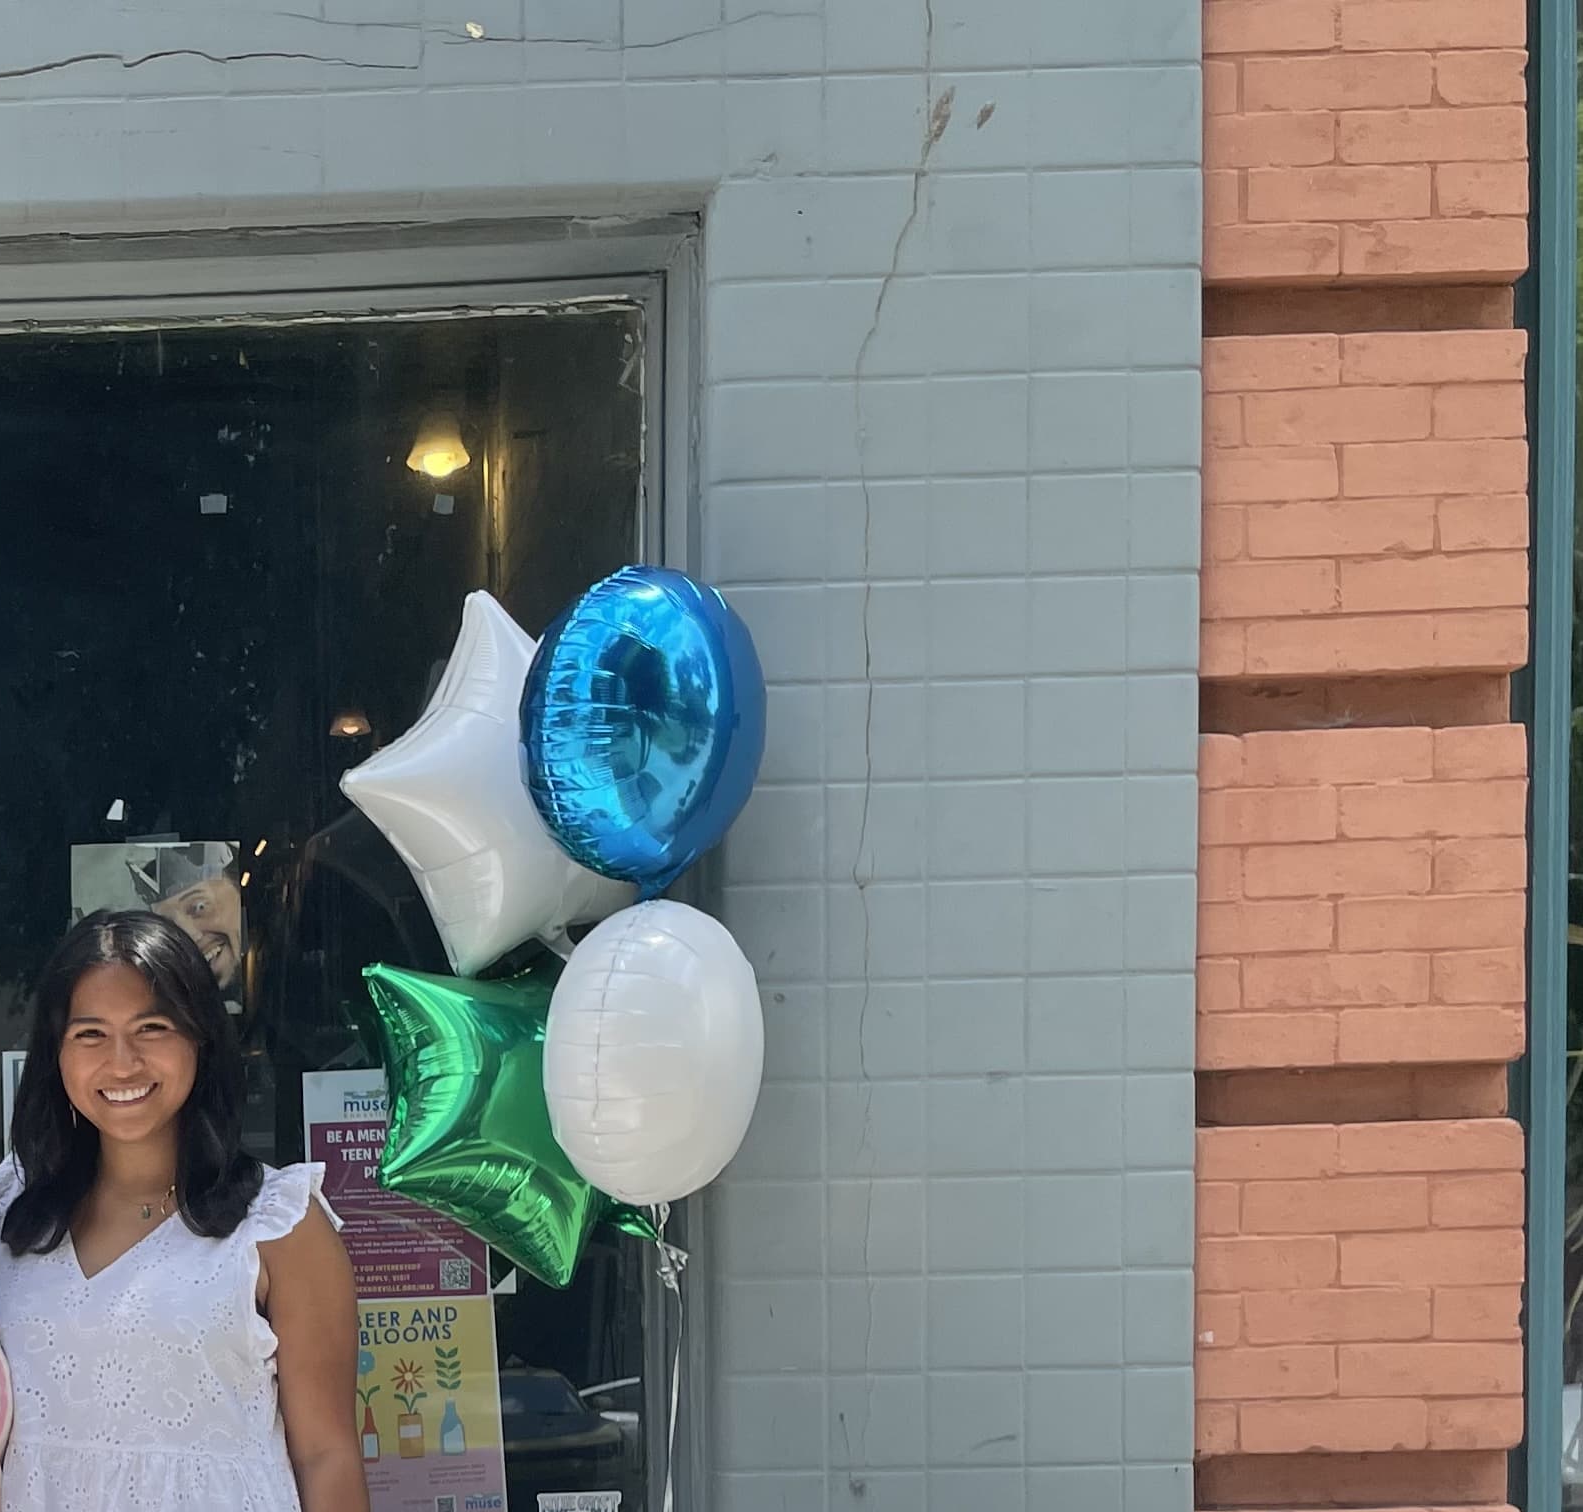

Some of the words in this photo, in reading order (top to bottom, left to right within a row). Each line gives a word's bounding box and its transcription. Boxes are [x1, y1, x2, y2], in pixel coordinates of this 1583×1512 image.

[326, 1130, 343, 1143] BE
[345, 1130, 355, 1142] A
[340, 1148, 372, 1161] TEEN
[411, 1306, 458, 1325] AND
[360, 1324, 452, 1346] BLOOMS
